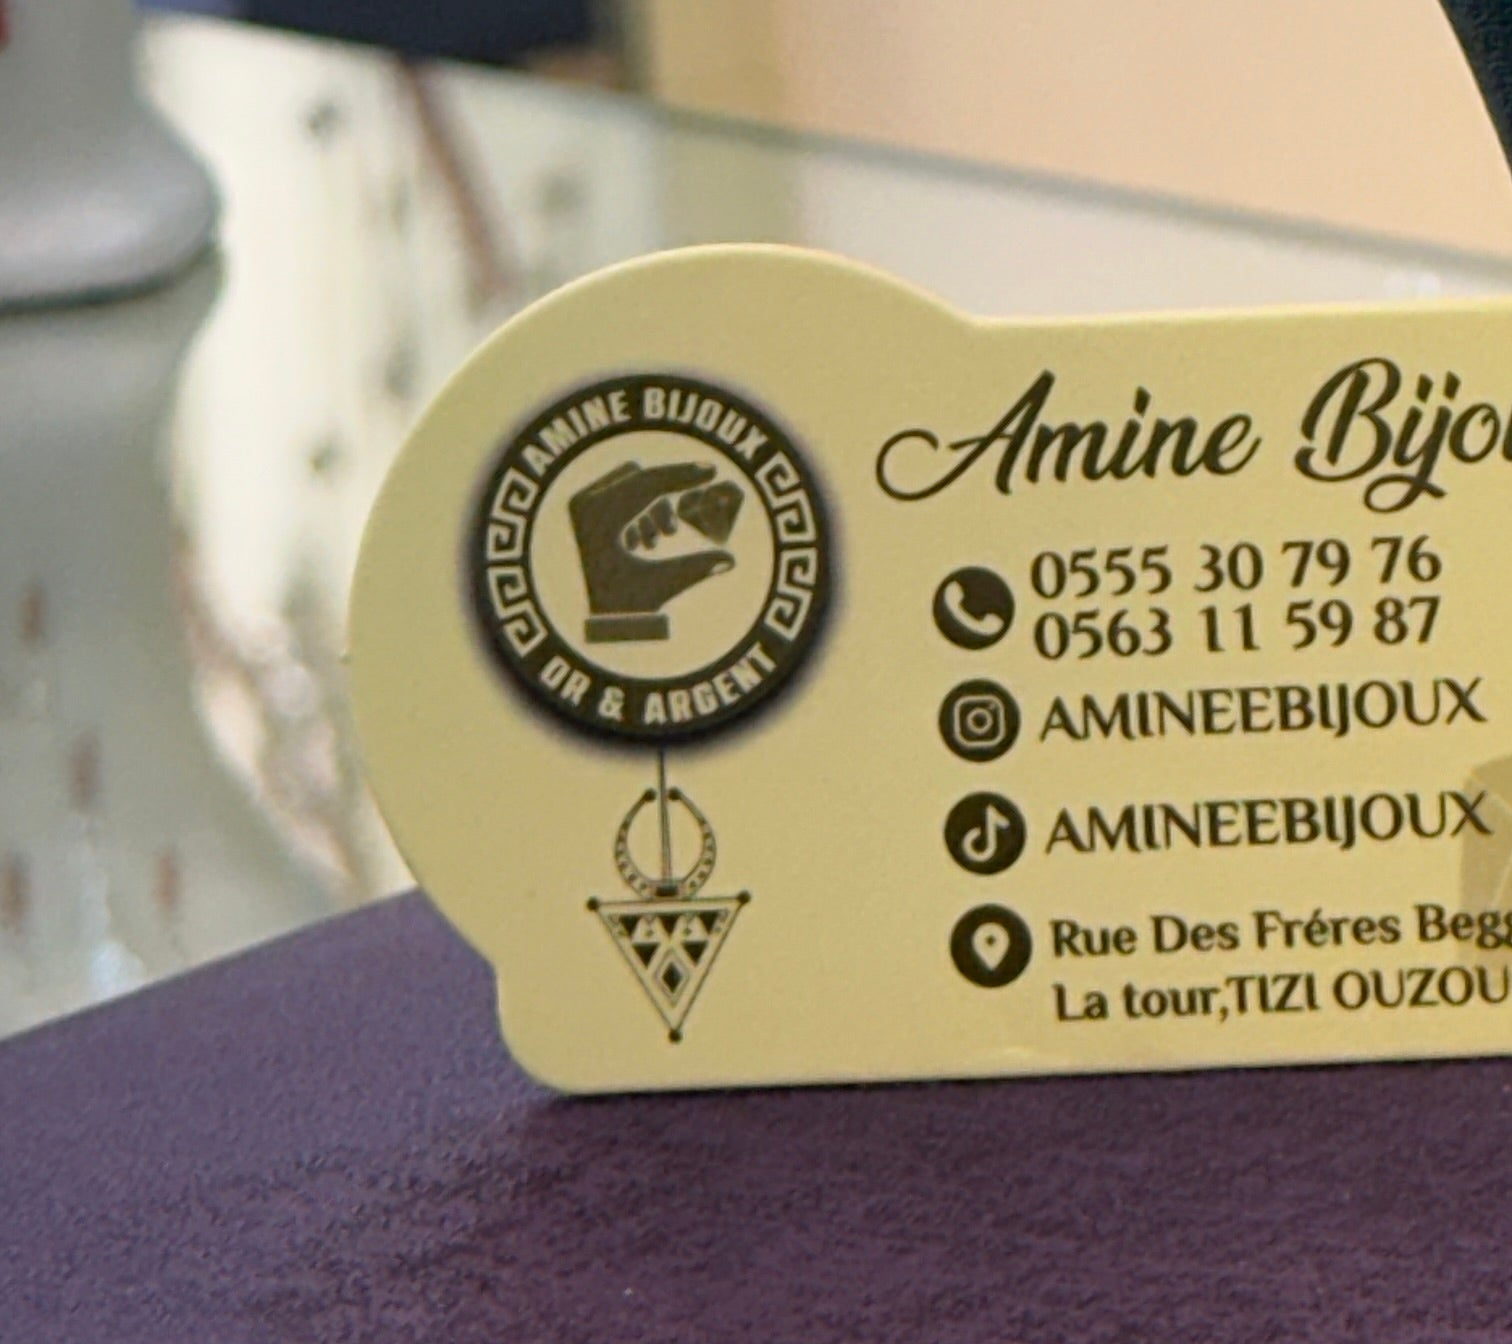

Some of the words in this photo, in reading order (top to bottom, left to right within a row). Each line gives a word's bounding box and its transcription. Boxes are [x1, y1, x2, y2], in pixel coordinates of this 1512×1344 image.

[522, 389, 632, 477] AMINE
[643, 387, 767, 459] BIJOUX
[875, 369, 1262, 502] Amine
[1030, 545, 1173, 600] 0555
[1193, 542, 1263, 593] 30
[1281, 539, 1350, 587] 79
[1371, 535, 1442, 585] 76
[1033, 609, 1173, 660] 0563
[1199, 605, 1260, 652] 11
[1285, 599, 1352, 648] 59
[1373, 595, 1441, 646] 87
[540, 656, 592, 707] OR
[599, 686, 627, 722] &
[643, 641, 777, 725] ARGENT
[1038, 676, 1488, 743] AMINEEBIJOUX
[1044, 790, 1495, 855] AMINEEBIJOUX
[1050, 918, 1138, 958] Rue
[1150, 914, 1239, 954] Des
[1255, 907, 1401, 950] Fréres
[1053, 983, 1109, 1022] La
[1331, 964, 1512, 1010] OUZOU
